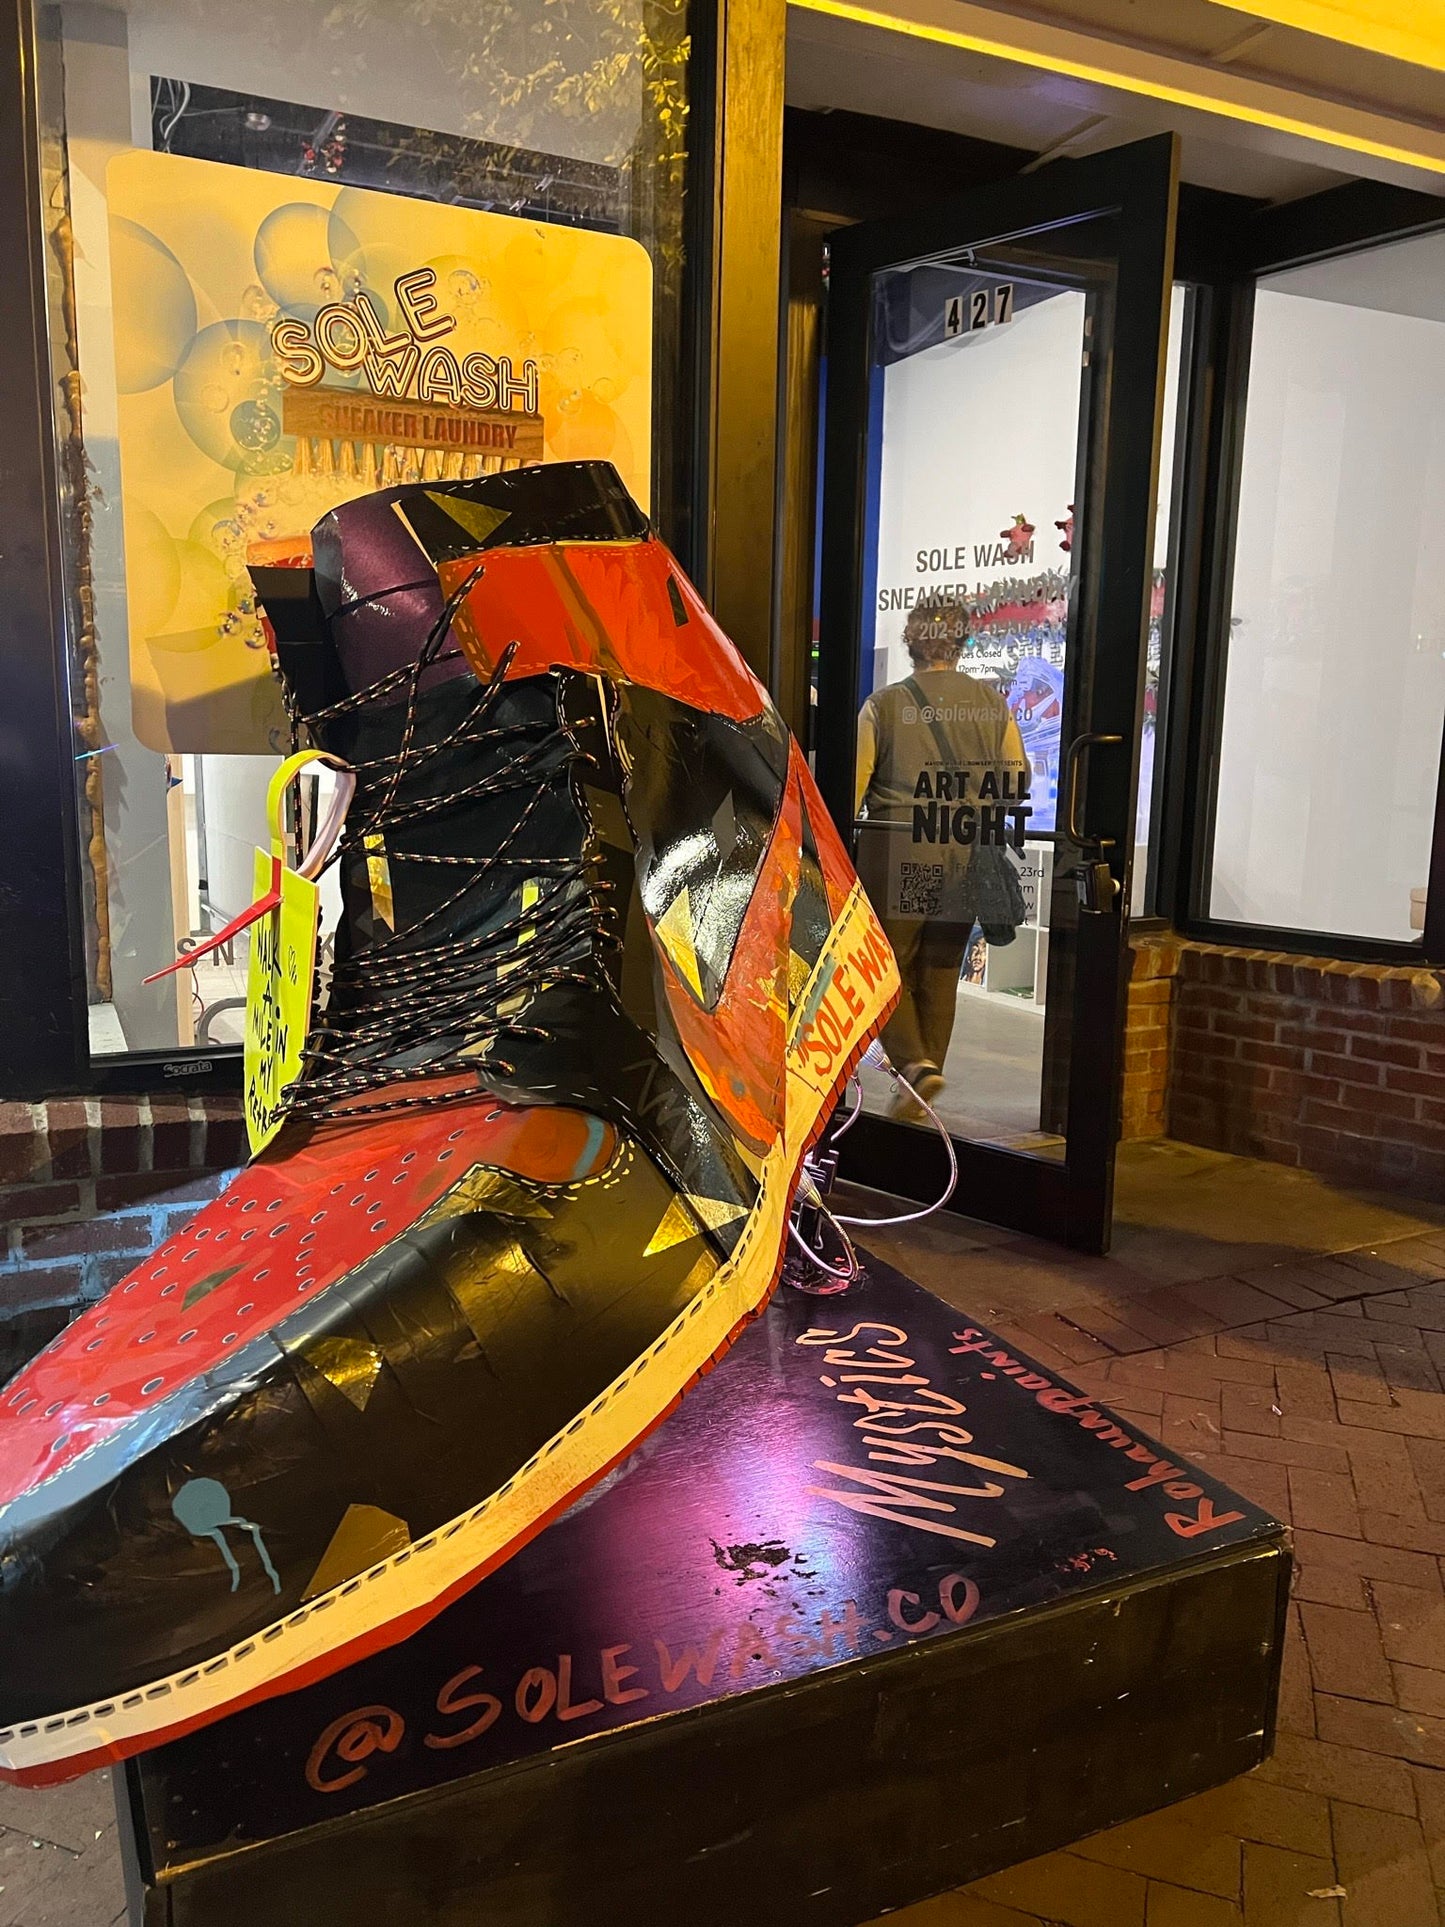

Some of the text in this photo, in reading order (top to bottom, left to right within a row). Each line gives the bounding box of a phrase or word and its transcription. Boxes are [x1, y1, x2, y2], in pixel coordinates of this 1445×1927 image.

[271, 267, 457, 387] SOLE
[947, 285, 1011, 334] 427
[364, 344, 540, 416] WASH
[324, 403, 518, 450] SNEAKER LAUNDRY
[916, 540, 1035, 573] SOLE WASH
[878, 583, 968, 612] SNEAKER
[914, 771, 1031, 801] ART ALL
[912, 801, 1033, 848] NIGHT
[257, 918, 282, 983] WALK
[253, 1004, 273, 1052] MILE
[260, 1055, 273, 1095] MY
